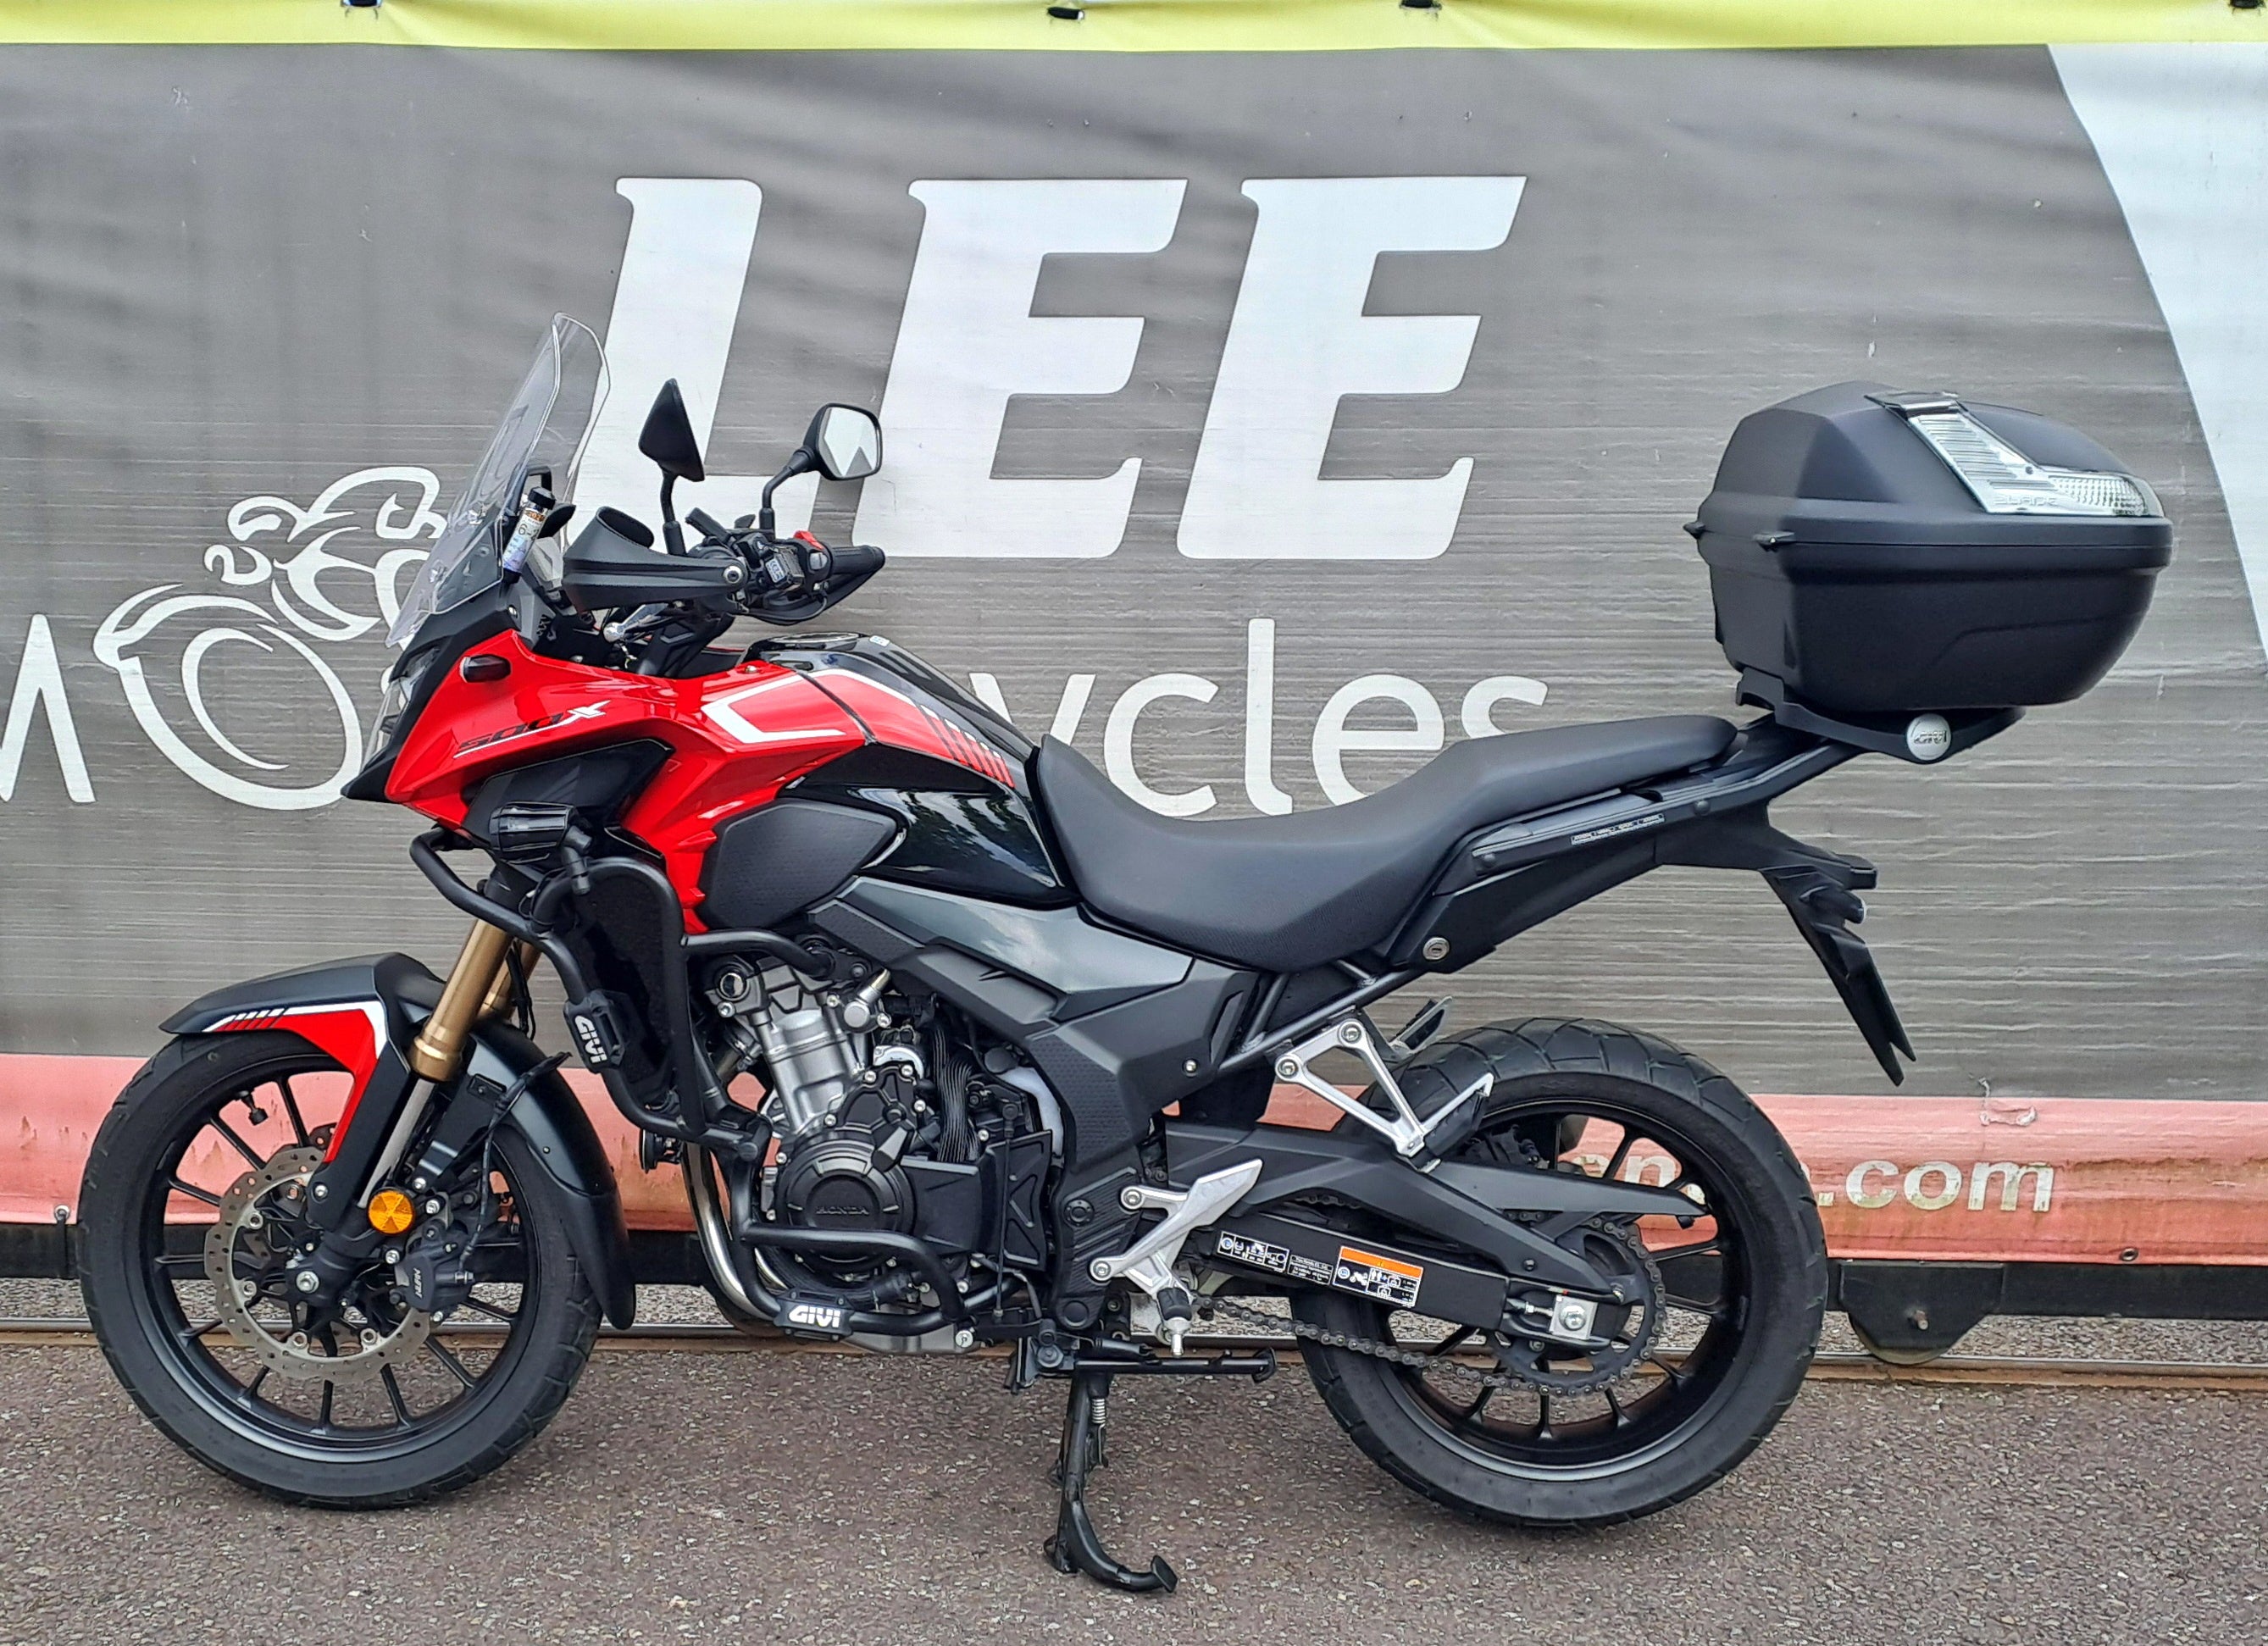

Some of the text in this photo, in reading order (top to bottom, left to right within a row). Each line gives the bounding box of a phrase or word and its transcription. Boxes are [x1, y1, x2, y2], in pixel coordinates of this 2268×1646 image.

[566, 175, 1528, 561] LEE
[574, 1015, 608, 1064] GIVI
[788, 1304, 842, 1329] GIVI
